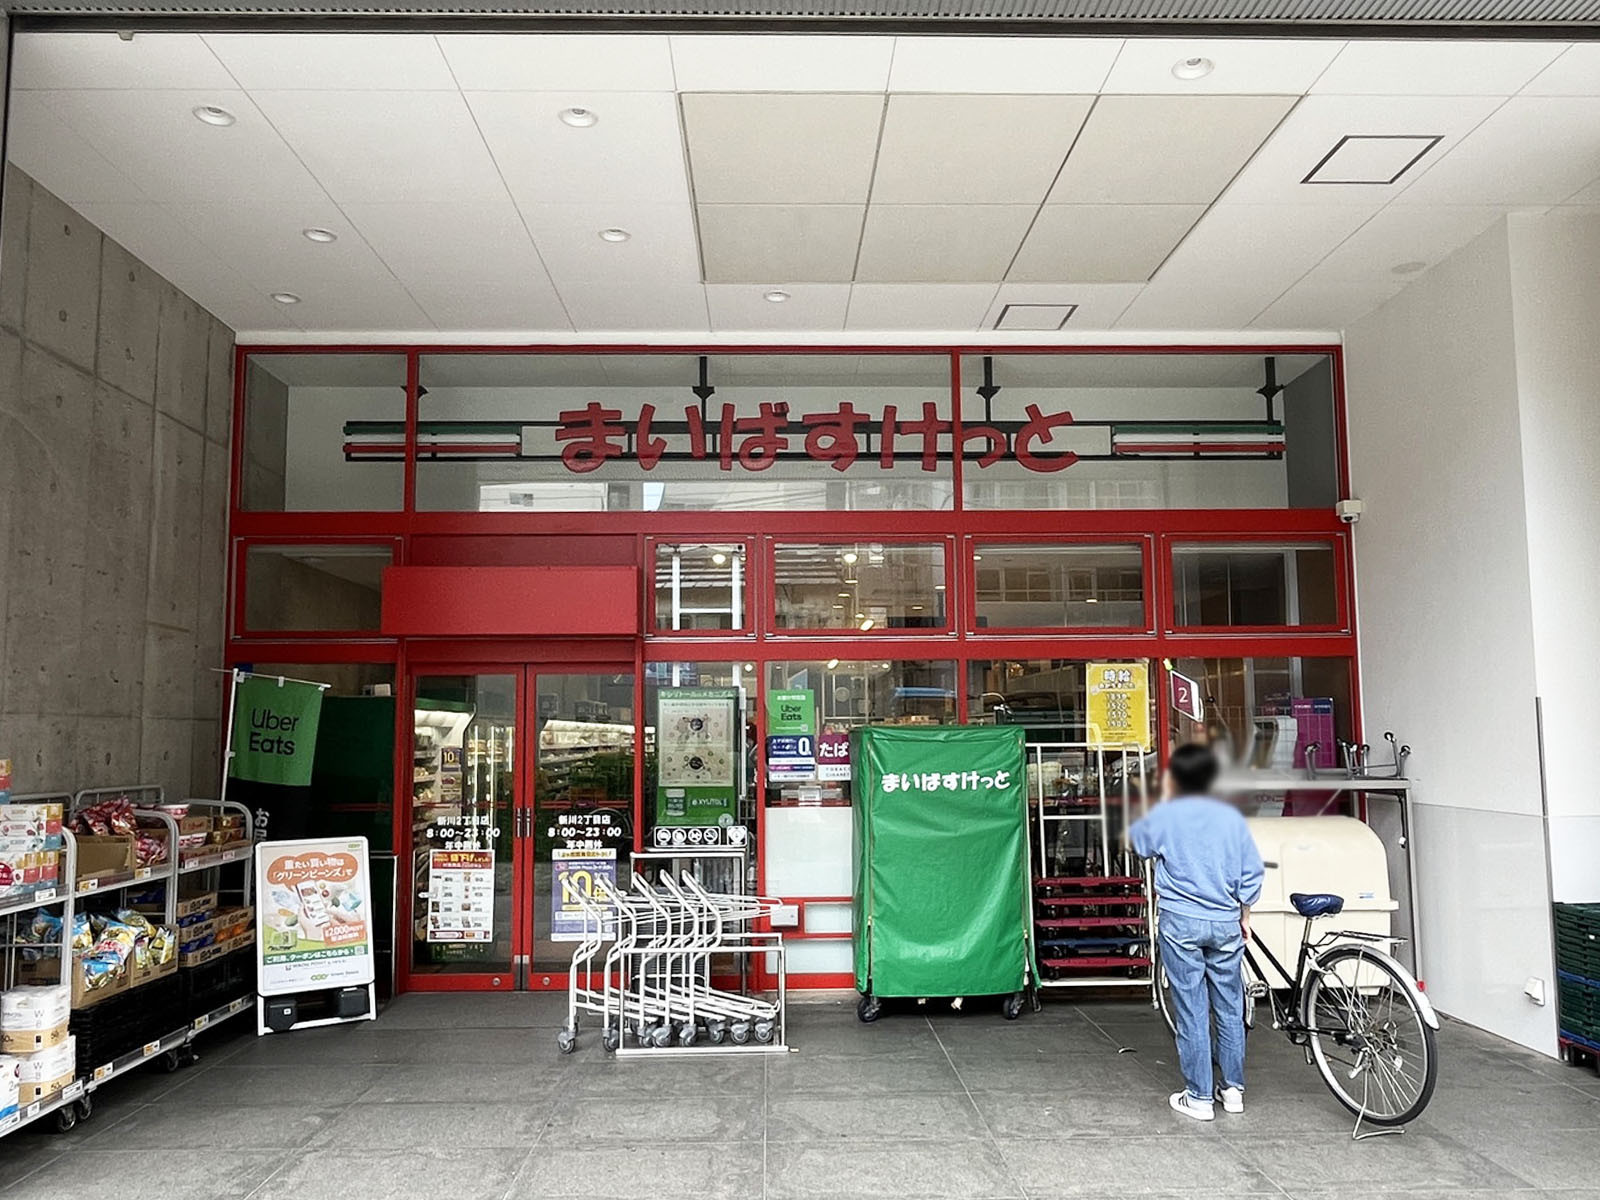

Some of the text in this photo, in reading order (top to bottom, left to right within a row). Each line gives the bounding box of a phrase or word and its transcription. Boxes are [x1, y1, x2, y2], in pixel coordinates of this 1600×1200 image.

[555, 402, 1079, 473] まいばすけっと
[1178, 687, 1188, 703] 2
[781, 705, 801, 713] Uber
[781, 713, 802, 721] Eats
[251, 708, 299, 731] Uber
[249, 731, 295, 755] Eats
[819, 741, 849, 758] たば
[558, 814, 611, 825] 新川2丁目店
[284, 857, 344, 870] 重たい買い物は
